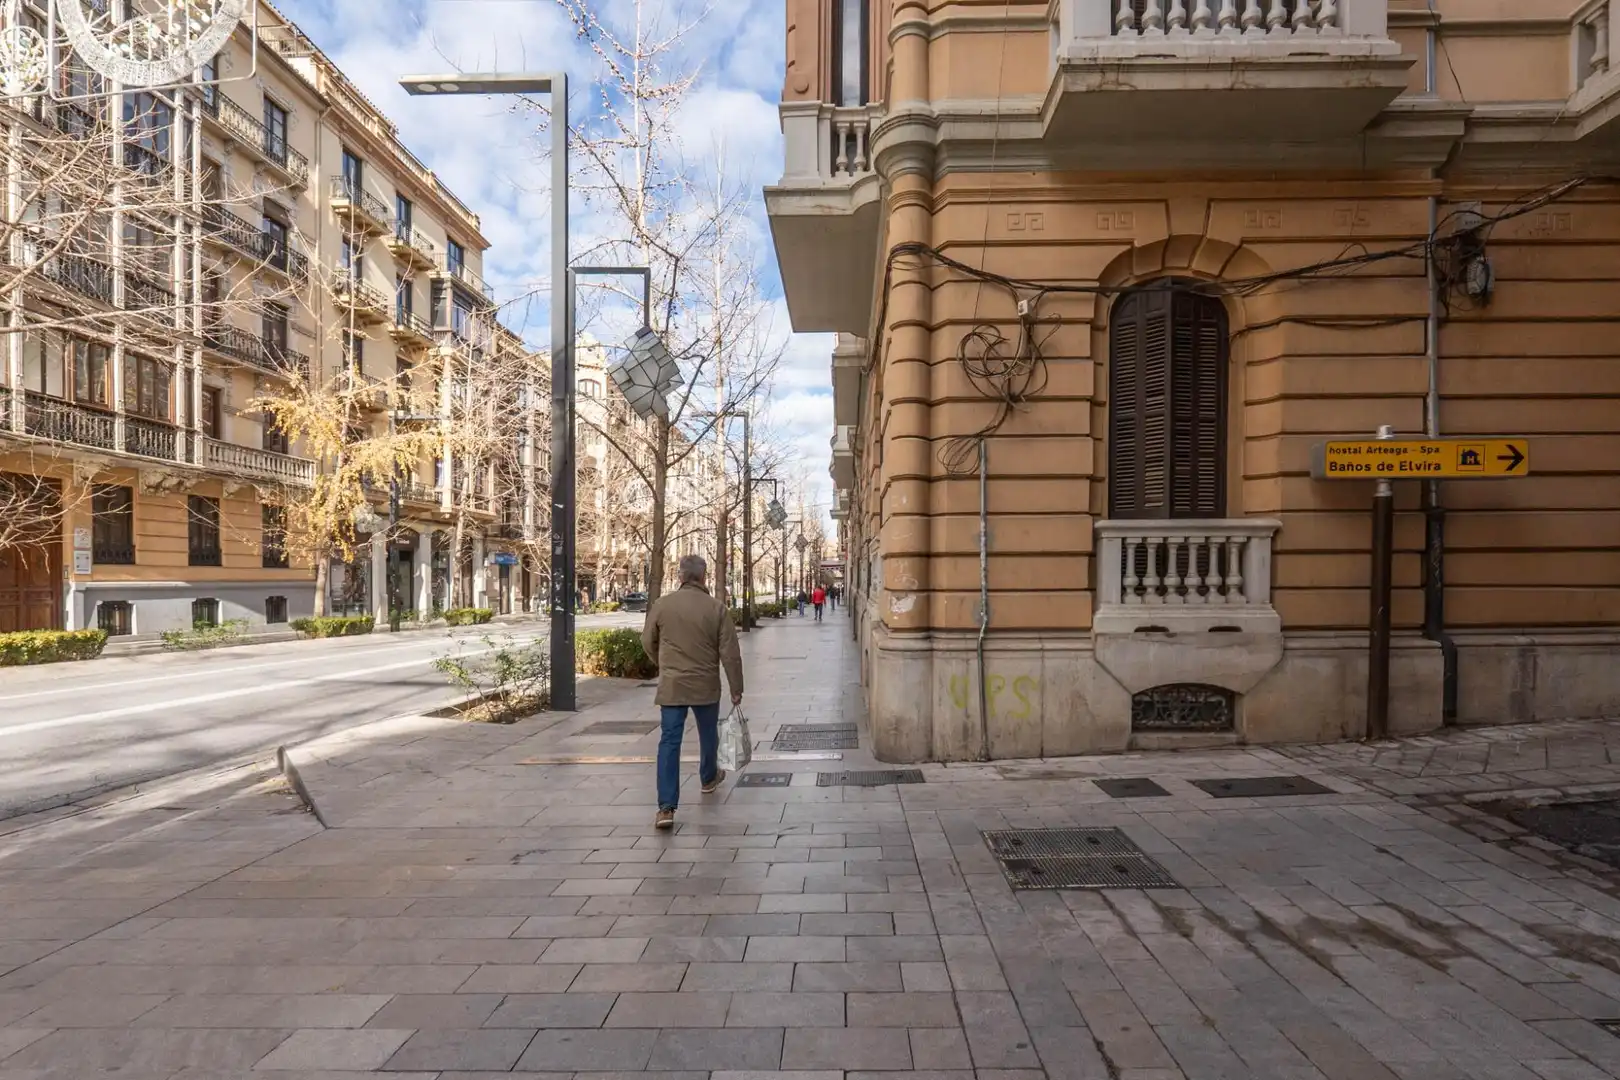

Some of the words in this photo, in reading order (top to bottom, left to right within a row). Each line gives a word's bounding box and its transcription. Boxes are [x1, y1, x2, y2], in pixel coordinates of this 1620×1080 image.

[1366, 446, 1408, 456] Arteaga
[1420, 445, 1440, 455] Spa
[1329, 461, 1371, 472] Baños
[1376, 461, 1394, 472] de
[1399, 460, 1442, 472] Elvira
